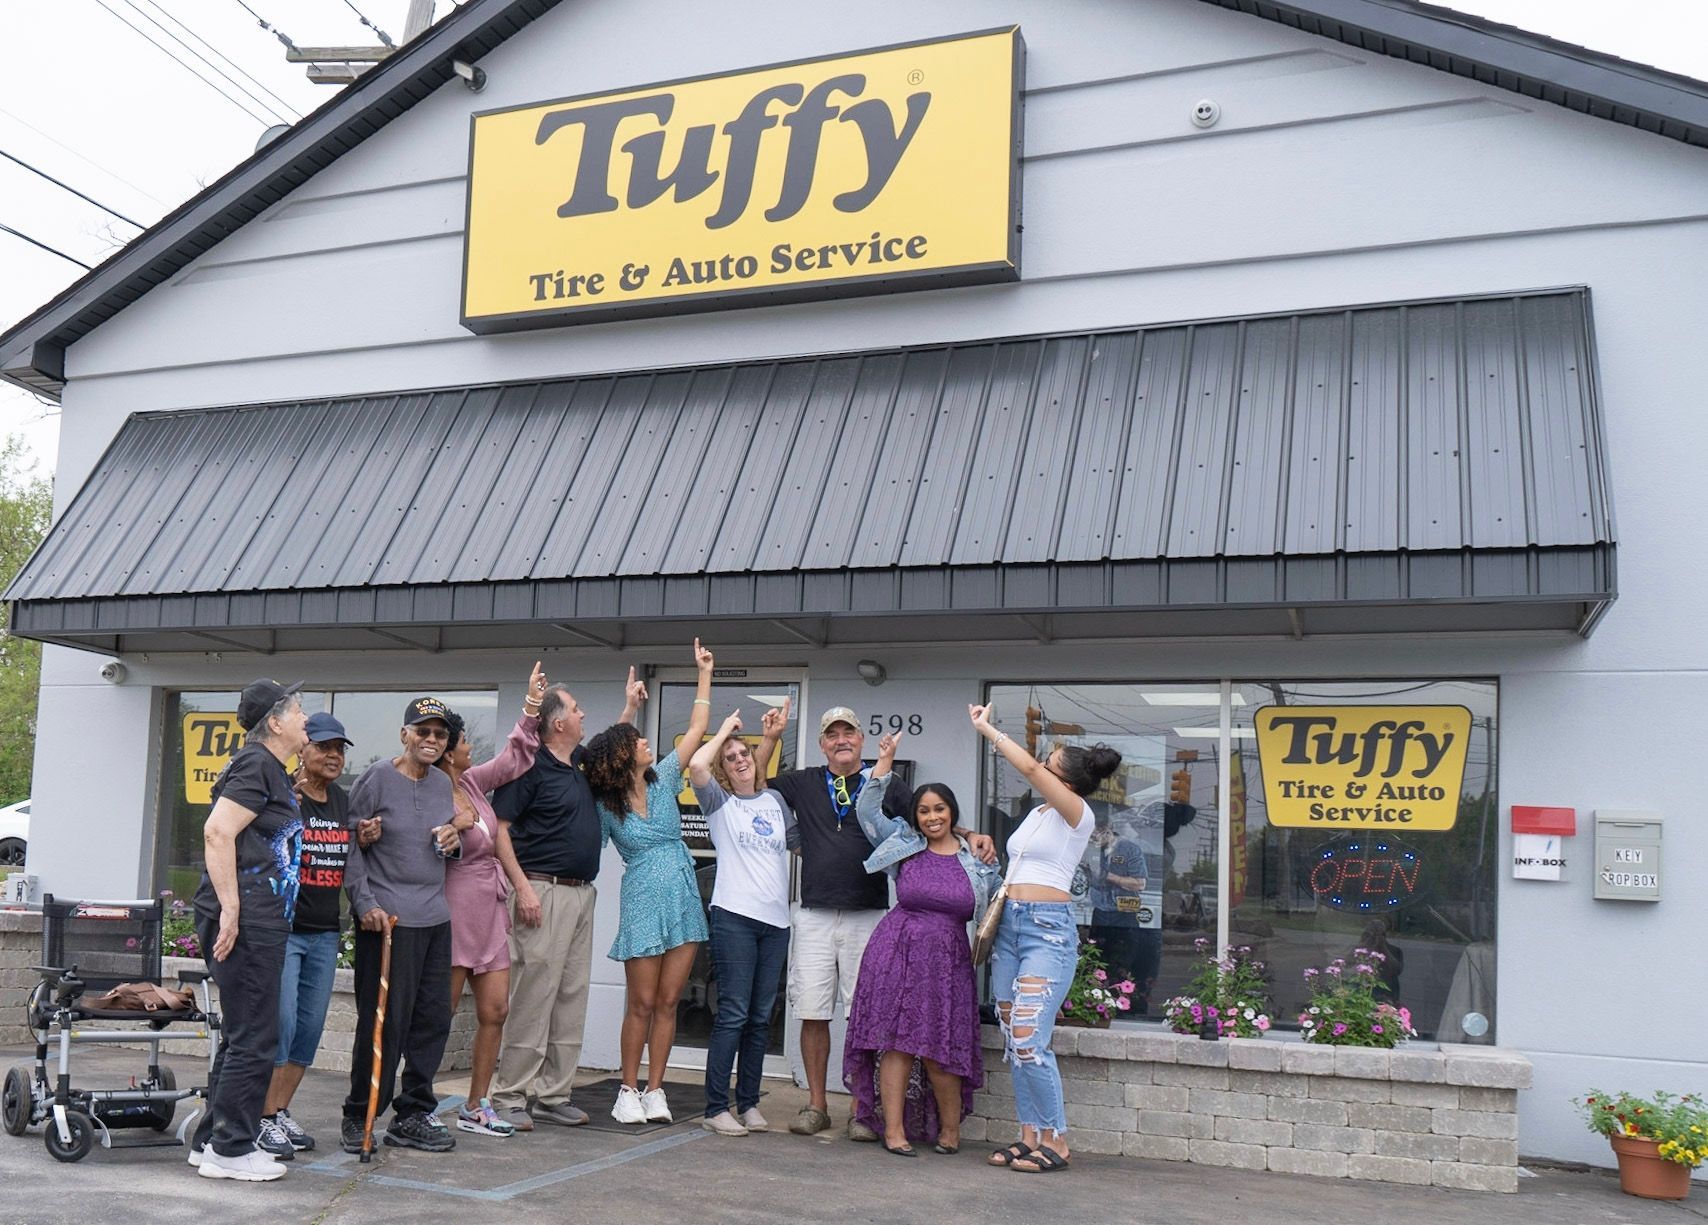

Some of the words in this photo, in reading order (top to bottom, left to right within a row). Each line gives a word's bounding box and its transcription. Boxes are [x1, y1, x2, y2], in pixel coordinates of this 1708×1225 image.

[535, 73, 931, 230] Tuffy
[529, 269, 605, 301] Tire
[619, 263, 649, 291] &
[662, 254, 758, 287] Auto
[769, 231, 928, 275] Service
[868, 713, 924, 736] 598
[191, 720, 247, 757] Tu
[1269, 716, 1455, 778] Tuffy
[193, 767, 224, 782] Tir
[1278, 780, 1335, 799] Tire
[1345, 781, 1367, 799] &
[1377, 782, 1446, 801] Auto
[1309, 803, 1413, 822] Service
[303, 830, 349, 842] RANDM
[1616, 849, 1641, 862] KEY
[300, 868, 342, 887] BLESS
[1311, 859, 1421, 894] OPEN
